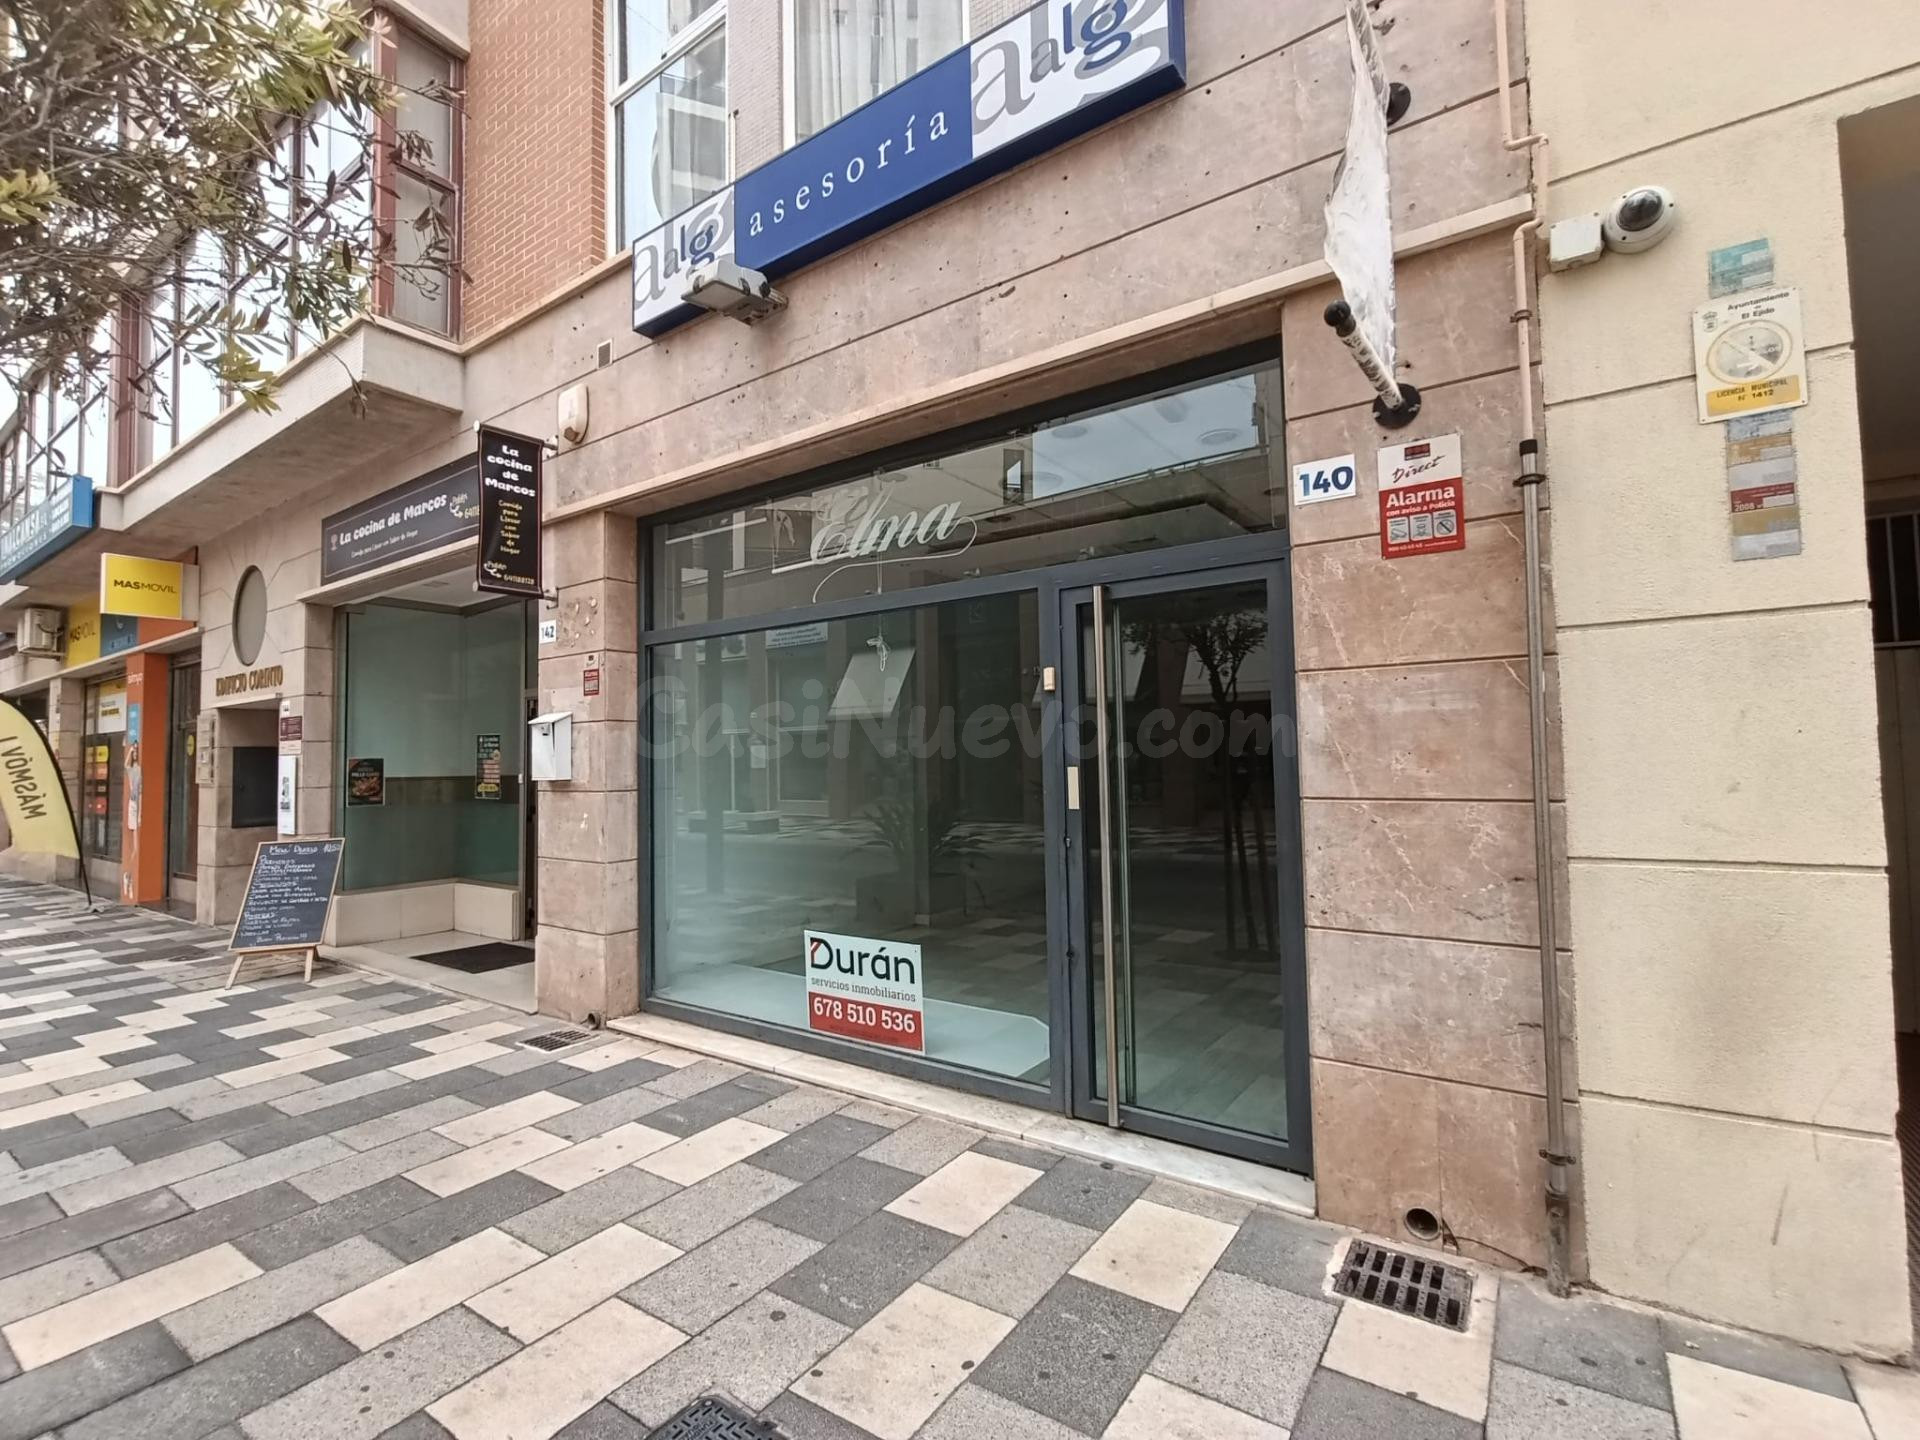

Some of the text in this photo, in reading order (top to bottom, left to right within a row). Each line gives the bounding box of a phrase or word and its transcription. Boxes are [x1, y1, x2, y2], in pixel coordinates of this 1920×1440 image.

[747, 107, 949, 237] asesoría
[1727, 292, 1790, 310] Ayuntamiento
[502, 444, 519, 457] La
[487, 455, 533, 472] cocina
[502, 470, 519, 481] de
[1299, 465, 1354, 497] 140
[485, 477, 536, 497] Marcos
[1386, 486, 1455, 508] Alarma
[339, 494, 448, 545] La cocina de Marcos
[810, 481, 977, 565] Elma
[1386, 509, 1400, 517] con
[113, 579, 177, 594] MASMOVIL
[540, 626, 555, 640] 142
[810, 937, 915, 984] Durán
[811, 977, 916, 1002] servicios inmobiliarios
[813, 997, 916, 1034] 678 510 536
